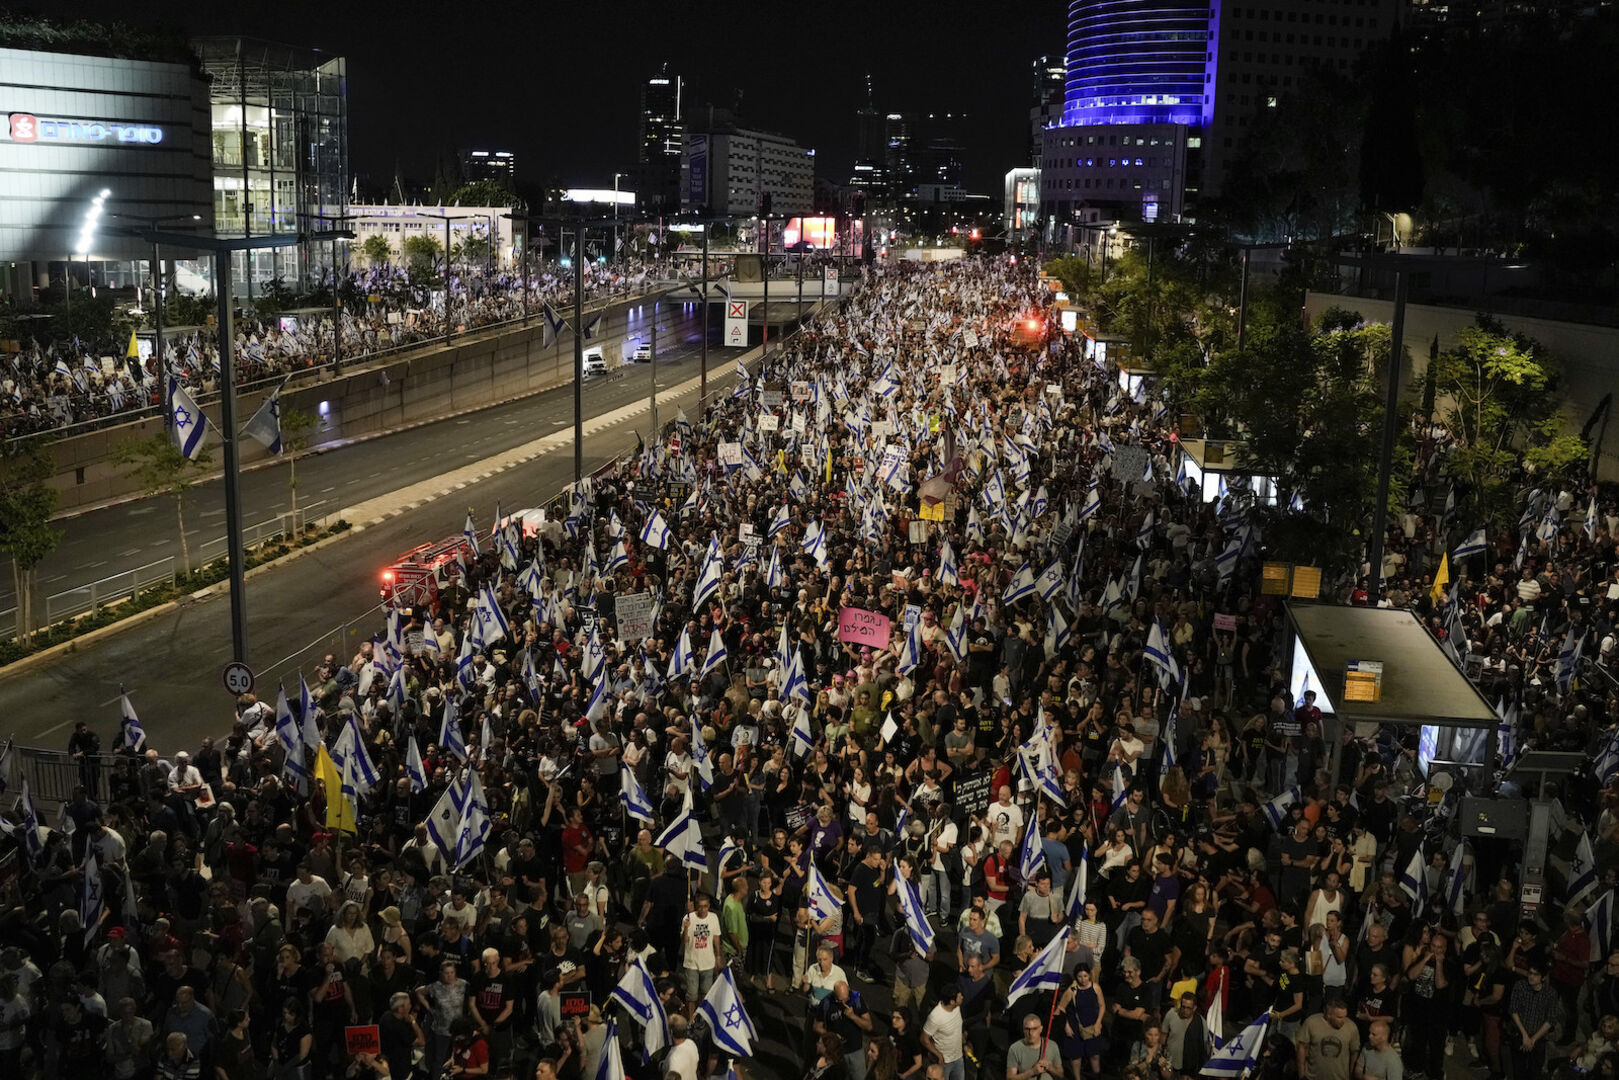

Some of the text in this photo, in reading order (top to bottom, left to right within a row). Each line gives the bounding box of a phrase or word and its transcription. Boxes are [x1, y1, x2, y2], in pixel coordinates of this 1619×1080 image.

[41, 120, 164, 144] סופר-פארם
[855, 613, 882, 626] נגמרו
[844, 623, 875, 636] המילים
[230, 674, 248, 688] 5.0
